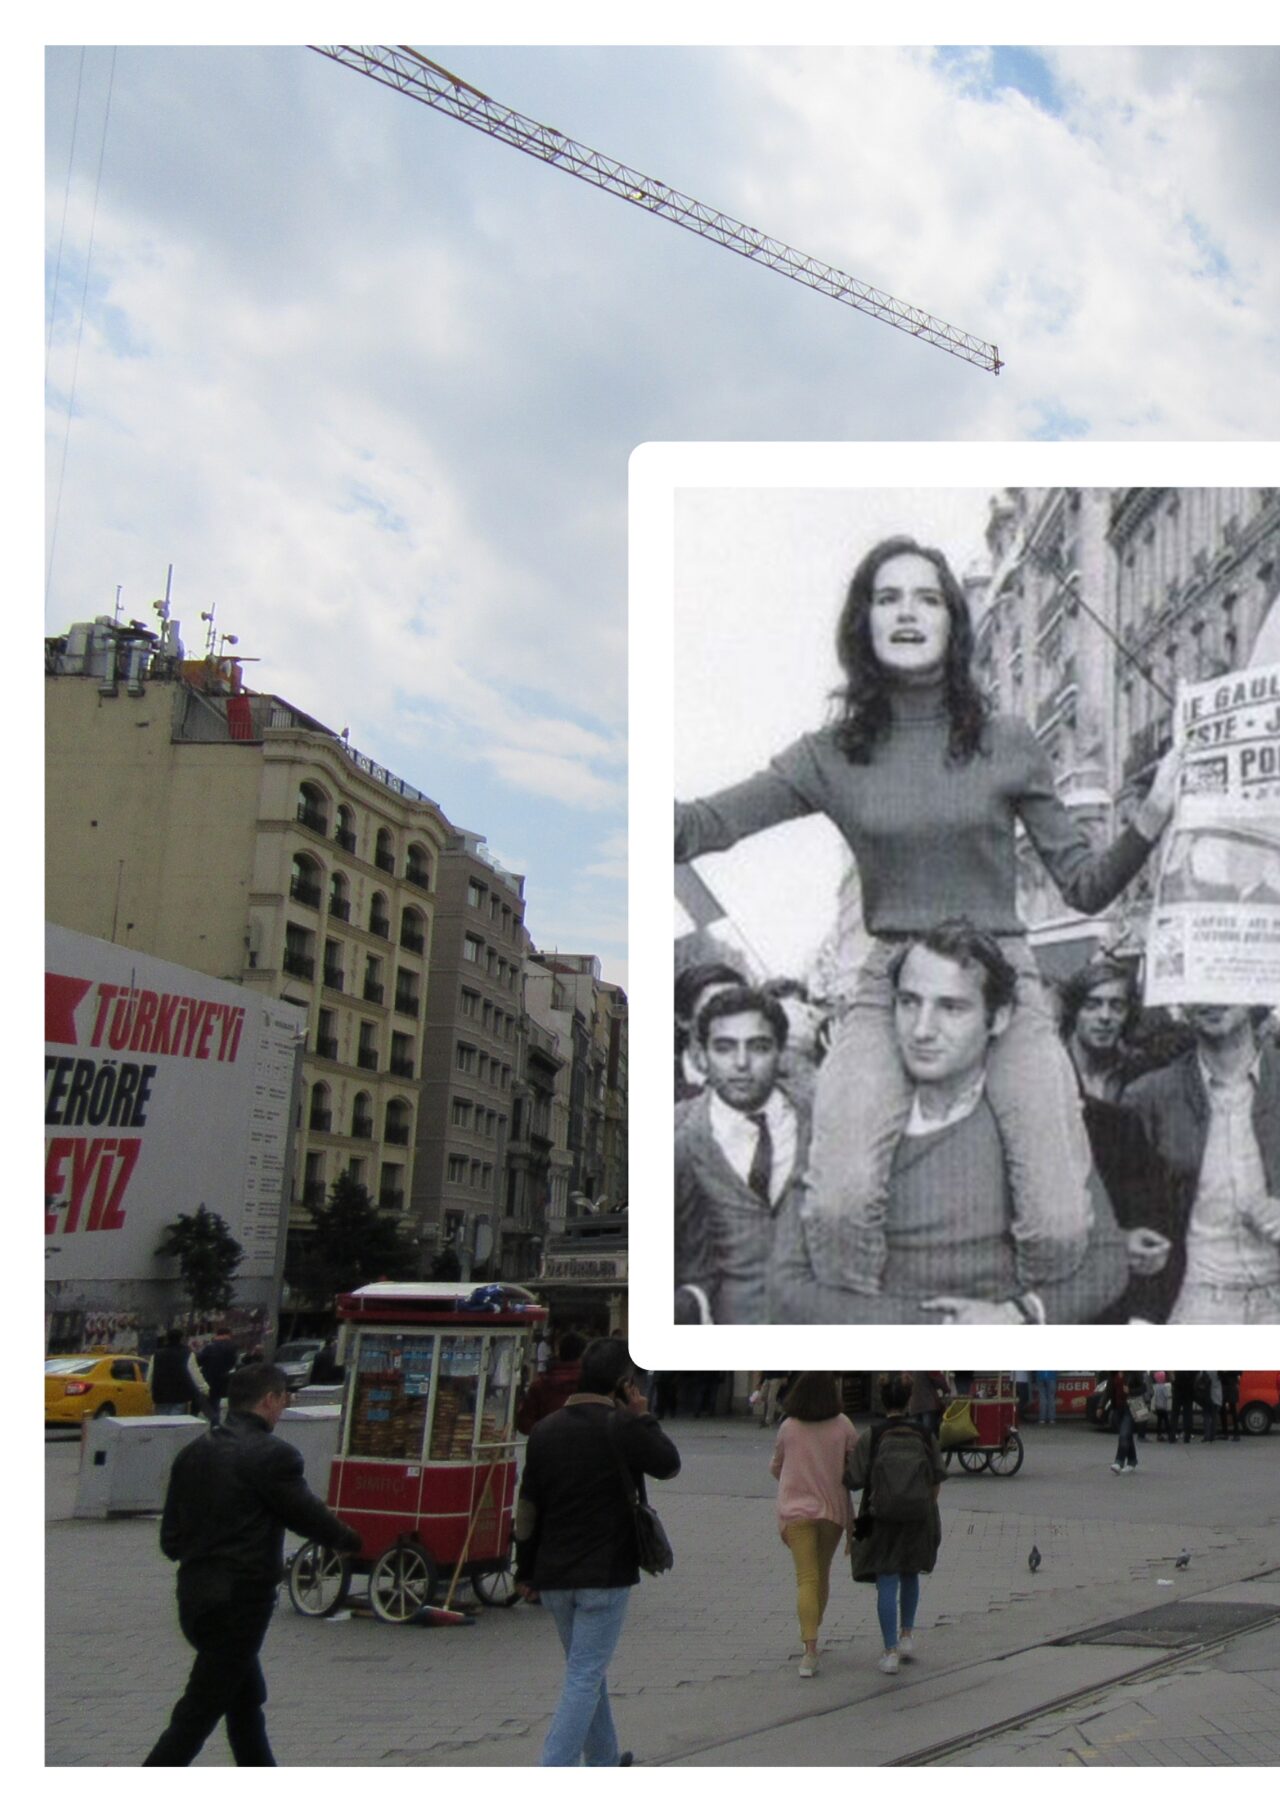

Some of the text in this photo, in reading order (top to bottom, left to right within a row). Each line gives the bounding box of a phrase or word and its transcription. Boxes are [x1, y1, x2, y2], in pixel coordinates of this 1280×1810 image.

[1187, 716, 1237, 743] STE
[91, 982, 246, 1063] TÜRKİYE'Yİ
[45, 1137, 142, 1235] EYİZ
[1058, 1381, 1090, 1391] RGER
